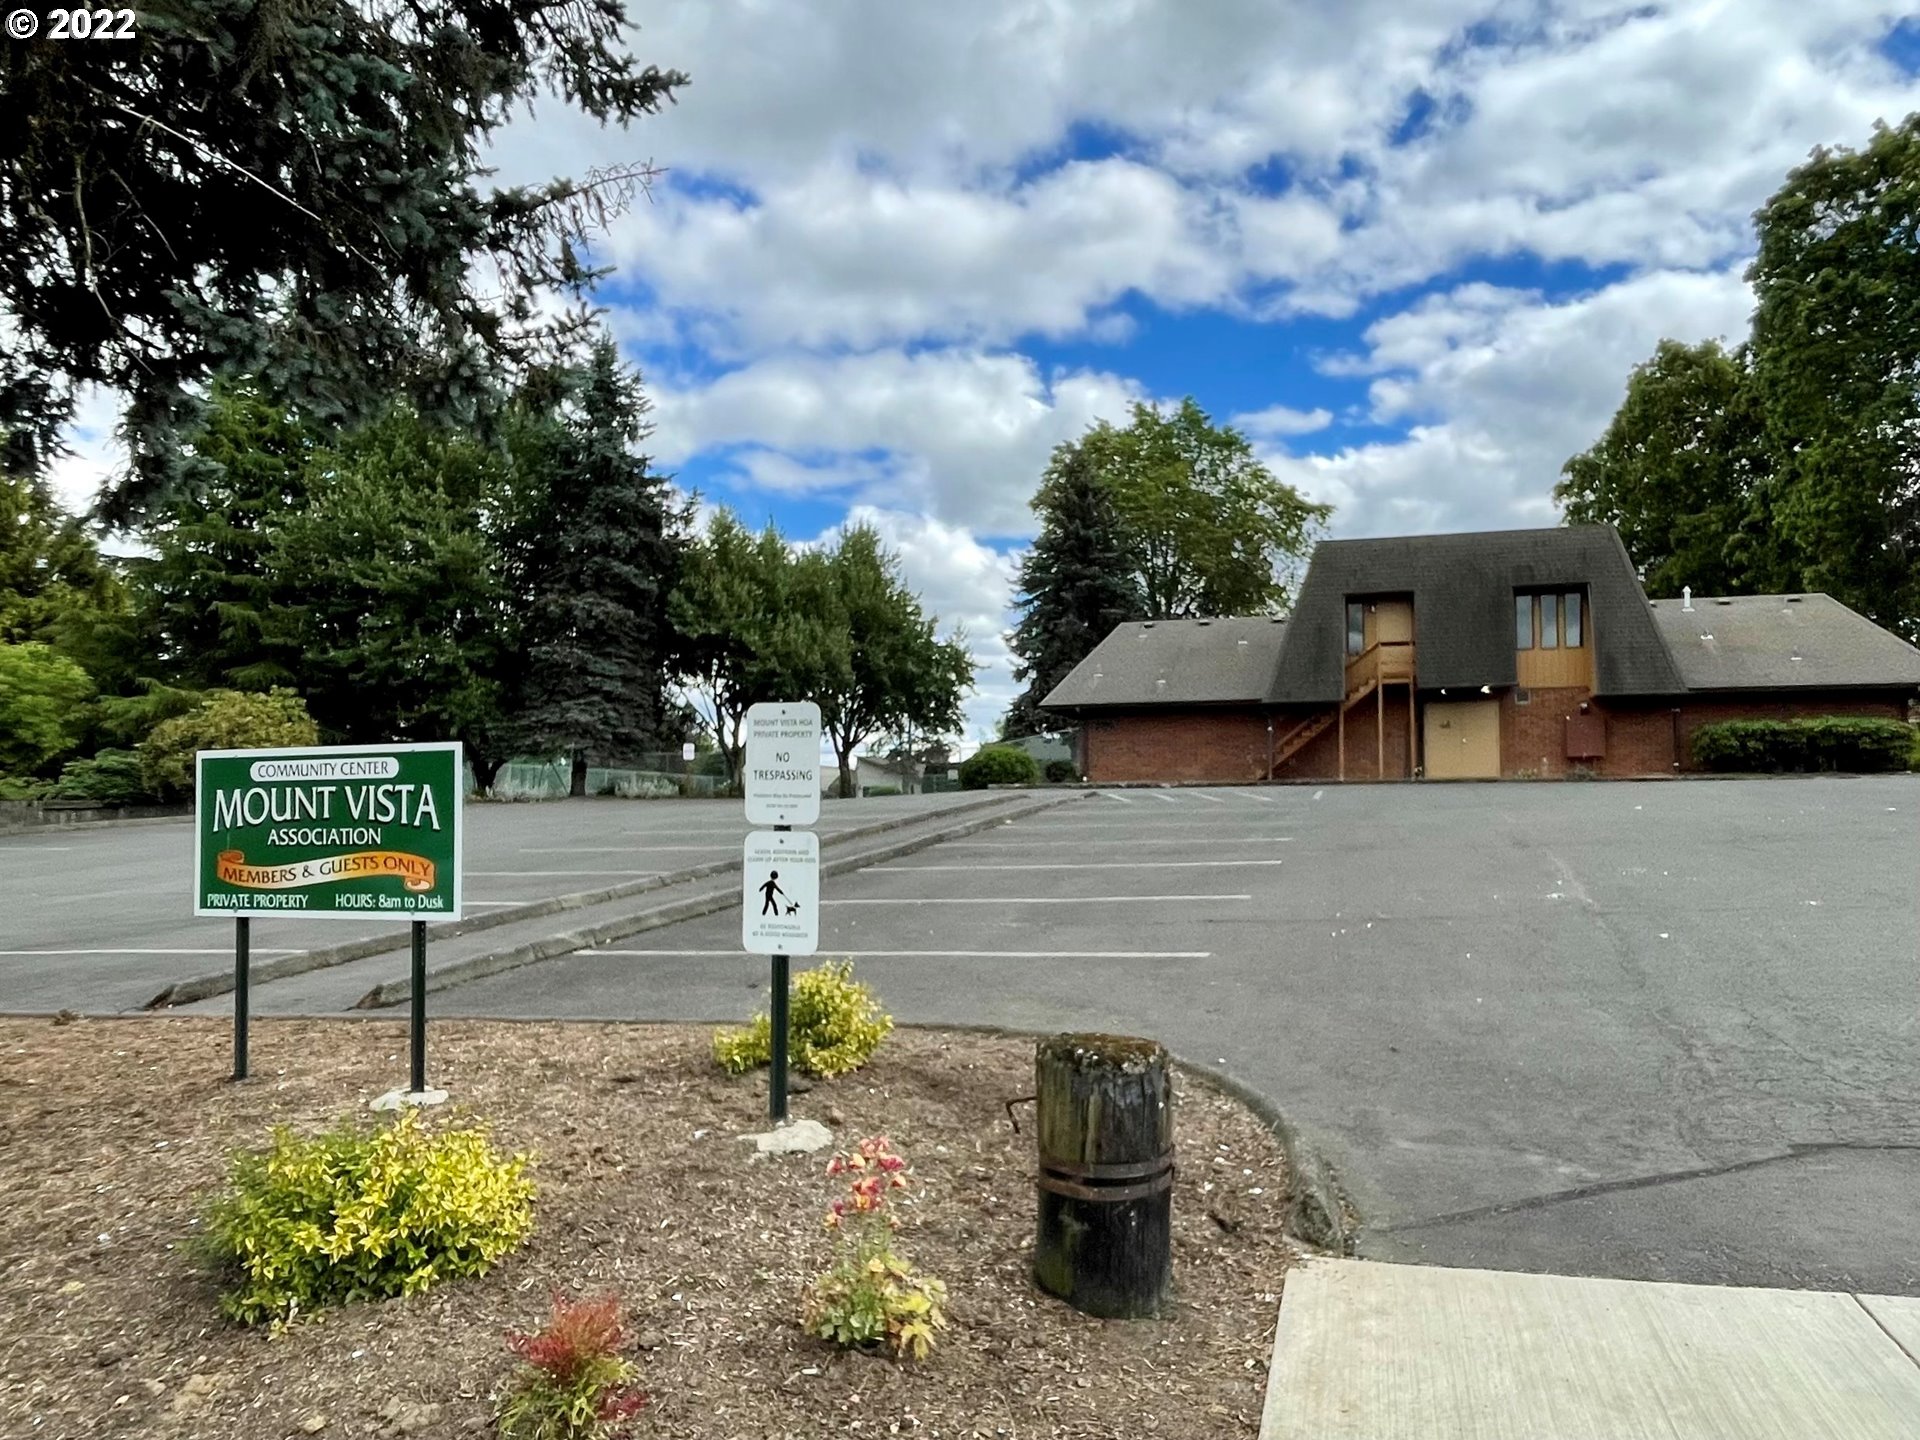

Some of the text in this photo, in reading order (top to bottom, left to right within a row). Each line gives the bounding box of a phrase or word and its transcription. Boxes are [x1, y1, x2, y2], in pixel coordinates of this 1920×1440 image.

[780, 718, 797, 726] VISTA
[799, 718, 813, 726] HOA
[753, 730, 813, 738] PRIVATE PROPERTY
[776, 752, 790, 762] NO
[258, 761, 389, 777] COMMUNITY CENTER
[753, 770, 813, 781] TRESPASSING
[213, 784, 440, 832] MOUNT VISTA
[268, 828, 382, 846] ASSOCIATION
[223, 856, 431, 884] MEMBERS & GUESTS ONLY
[207, 894, 309, 909] PRIVATE PROPERTY
[335, 894, 444, 909] HOURS: 8am to Dusk
